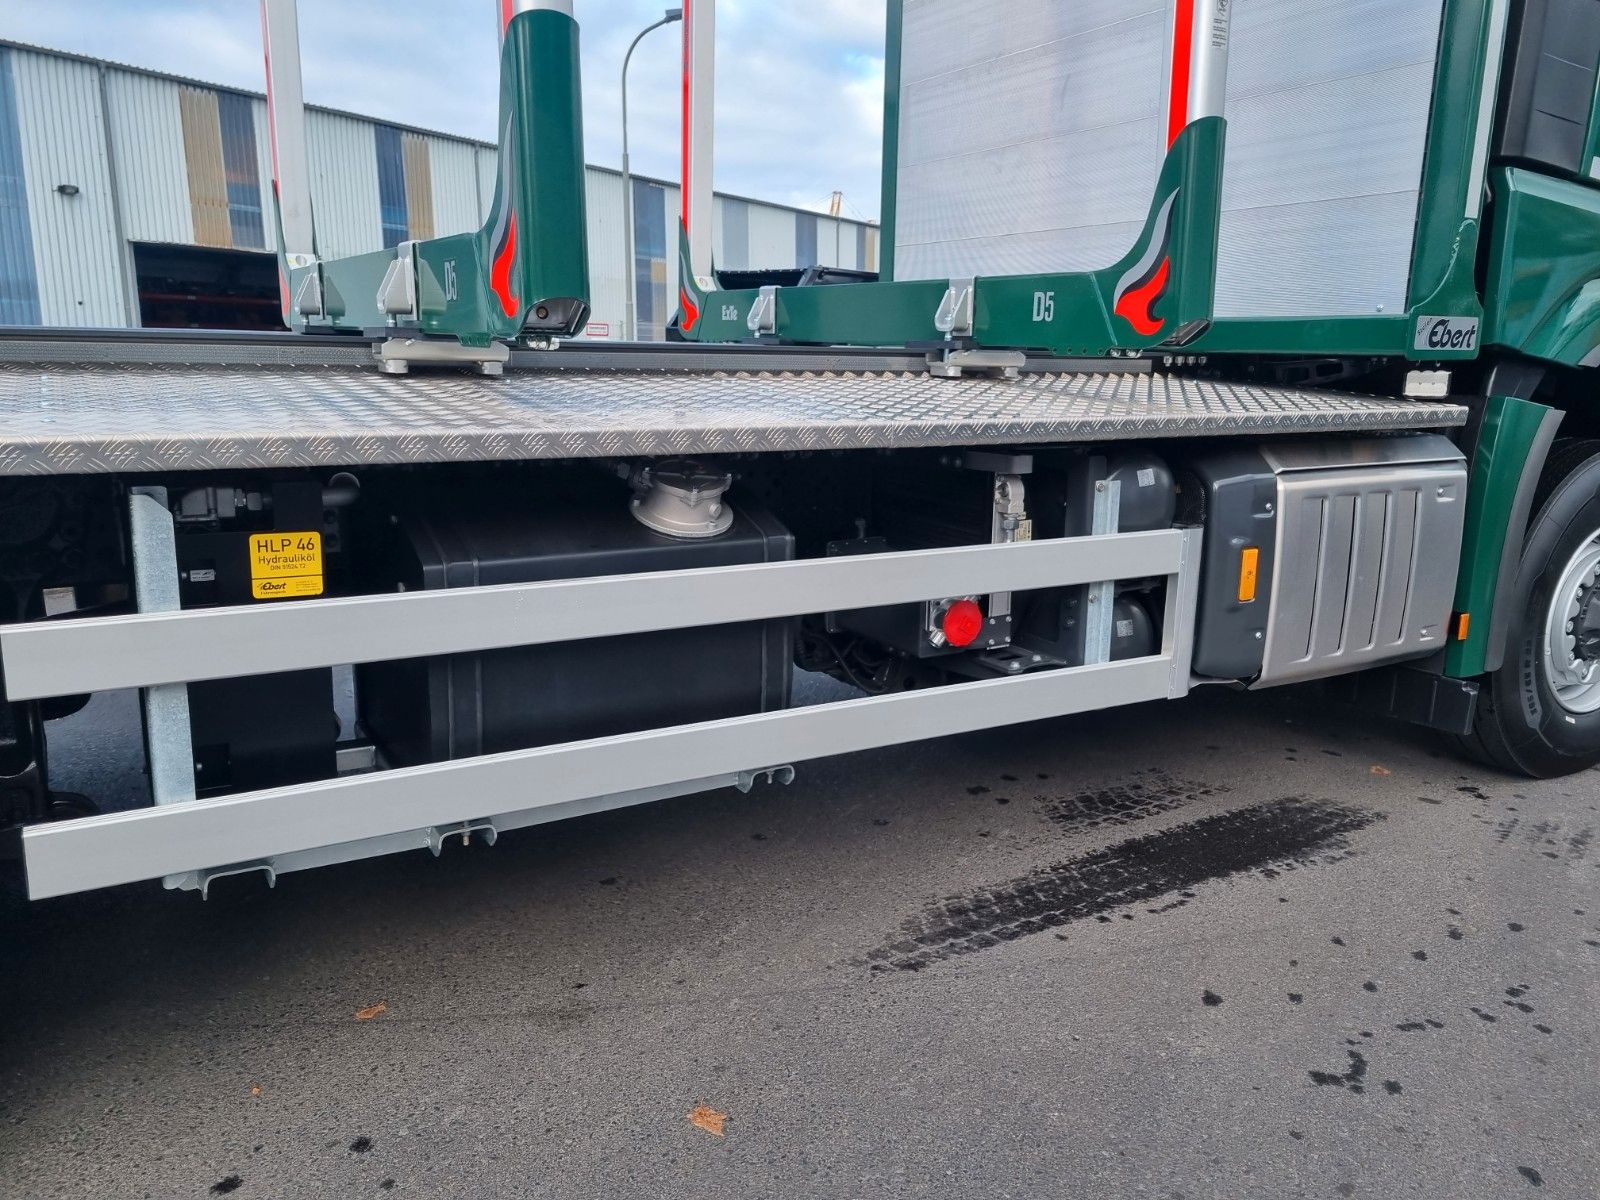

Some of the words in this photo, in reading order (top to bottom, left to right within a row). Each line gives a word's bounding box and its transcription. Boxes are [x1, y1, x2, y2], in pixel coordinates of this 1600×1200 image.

[444, 260, 458, 301] D5
[721, 304, 738, 321] ExTe
[1032, 291, 1055, 322] D5
[1428, 318, 1476, 349] Ebert
[257, 538, 292, 553] HLP
[296, 537, 315, 551] 46
[258, 553, 316, 566] Hydrauliköl
[261, 581, 288, 591] Ebert
